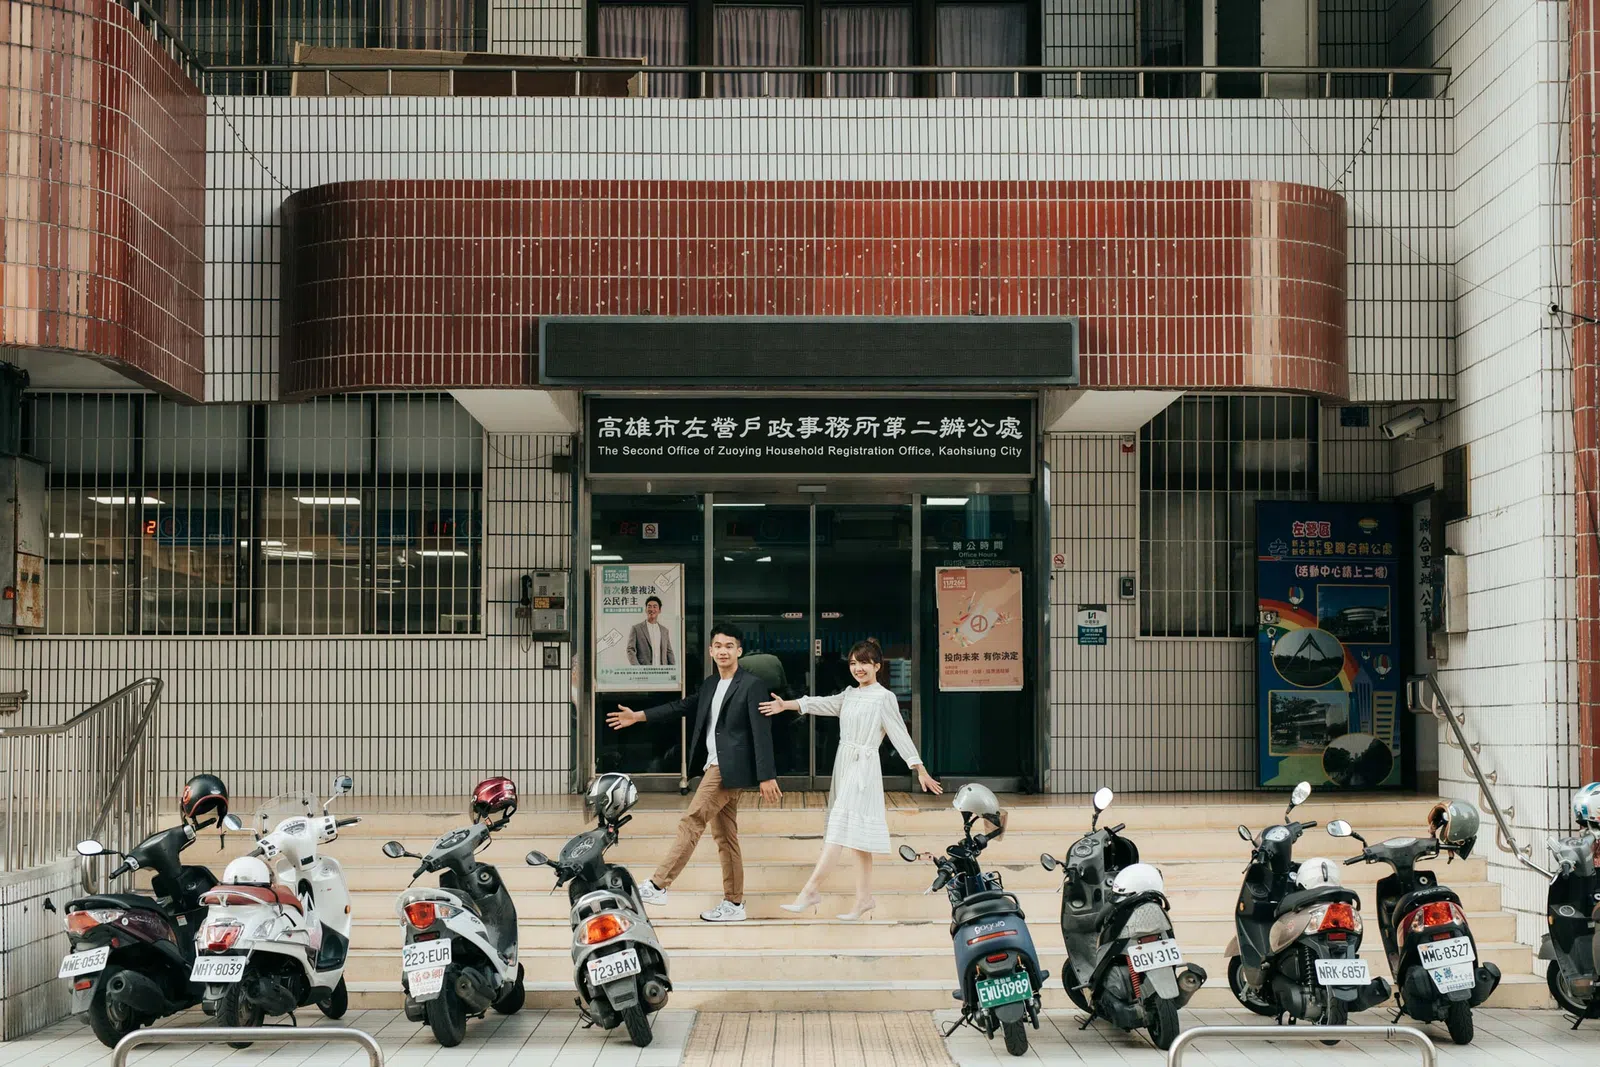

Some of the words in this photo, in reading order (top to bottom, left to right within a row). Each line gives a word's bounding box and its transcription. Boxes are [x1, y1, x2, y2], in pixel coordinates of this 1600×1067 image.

[597, 415, 1024, 439] 高雄市左營戶政事務所第二辦公處
[597, 445, 619, 456] The
[622, 445, 664, 456] Second
[667, 445, 700, 456] Office
[703, 445, 715, 456] of
[717, 445, 762, 458] Zuoying
[765, 445, 824, 456] Household
[827, 445, 895, 458] Registration
[898, 445, 935, 457] Office,
[938, 445, 997, 458] Kaohsiung
[1000, 445, 1023, 458] City
[1292, 521, 1331, 538] 左營區
[952, 541, 1003, 550] 辦公時間
[602, 596, 639, 606] 公民作主
[944, 652, 980, 662] 投向未來
[983, 651, 1019, 661] 有你決定
[974, 920, 1006, 935] gogoro
